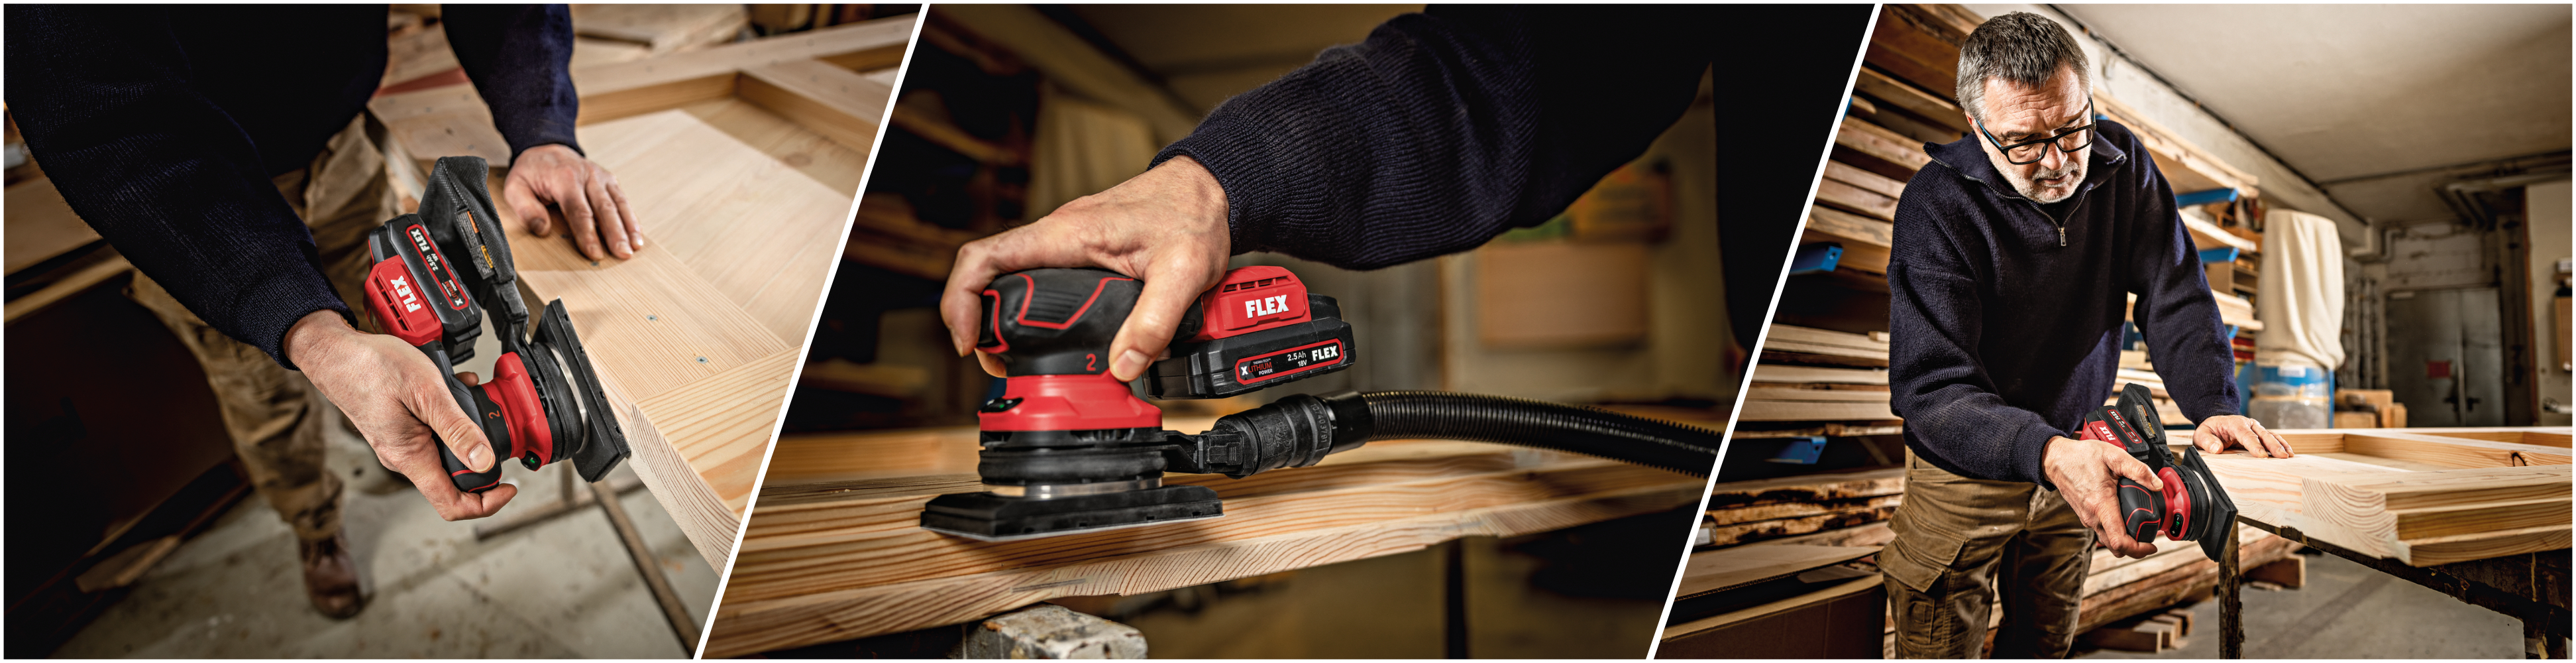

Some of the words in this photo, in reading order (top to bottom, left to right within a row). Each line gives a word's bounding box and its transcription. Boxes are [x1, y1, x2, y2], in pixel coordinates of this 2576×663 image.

[411, 229, 430, 252] FLEX
[390, 275, 421, 313] FLEX
[444, 280, 458, 300] LITHIUM
[1245, 294, 1289, 318] FLEX
[1312, 345, 1338, 361] FLEX
[1086, 353, 1097, 371] 2
[1240, 365, 1248, 376] X
[1248, 362, 1272, 373] LITHIUM
[488, 410, 500, 419] 2
[2110, 411, 2121, 420] FLEX
[2099, 426, 2116, 441] FLEX
